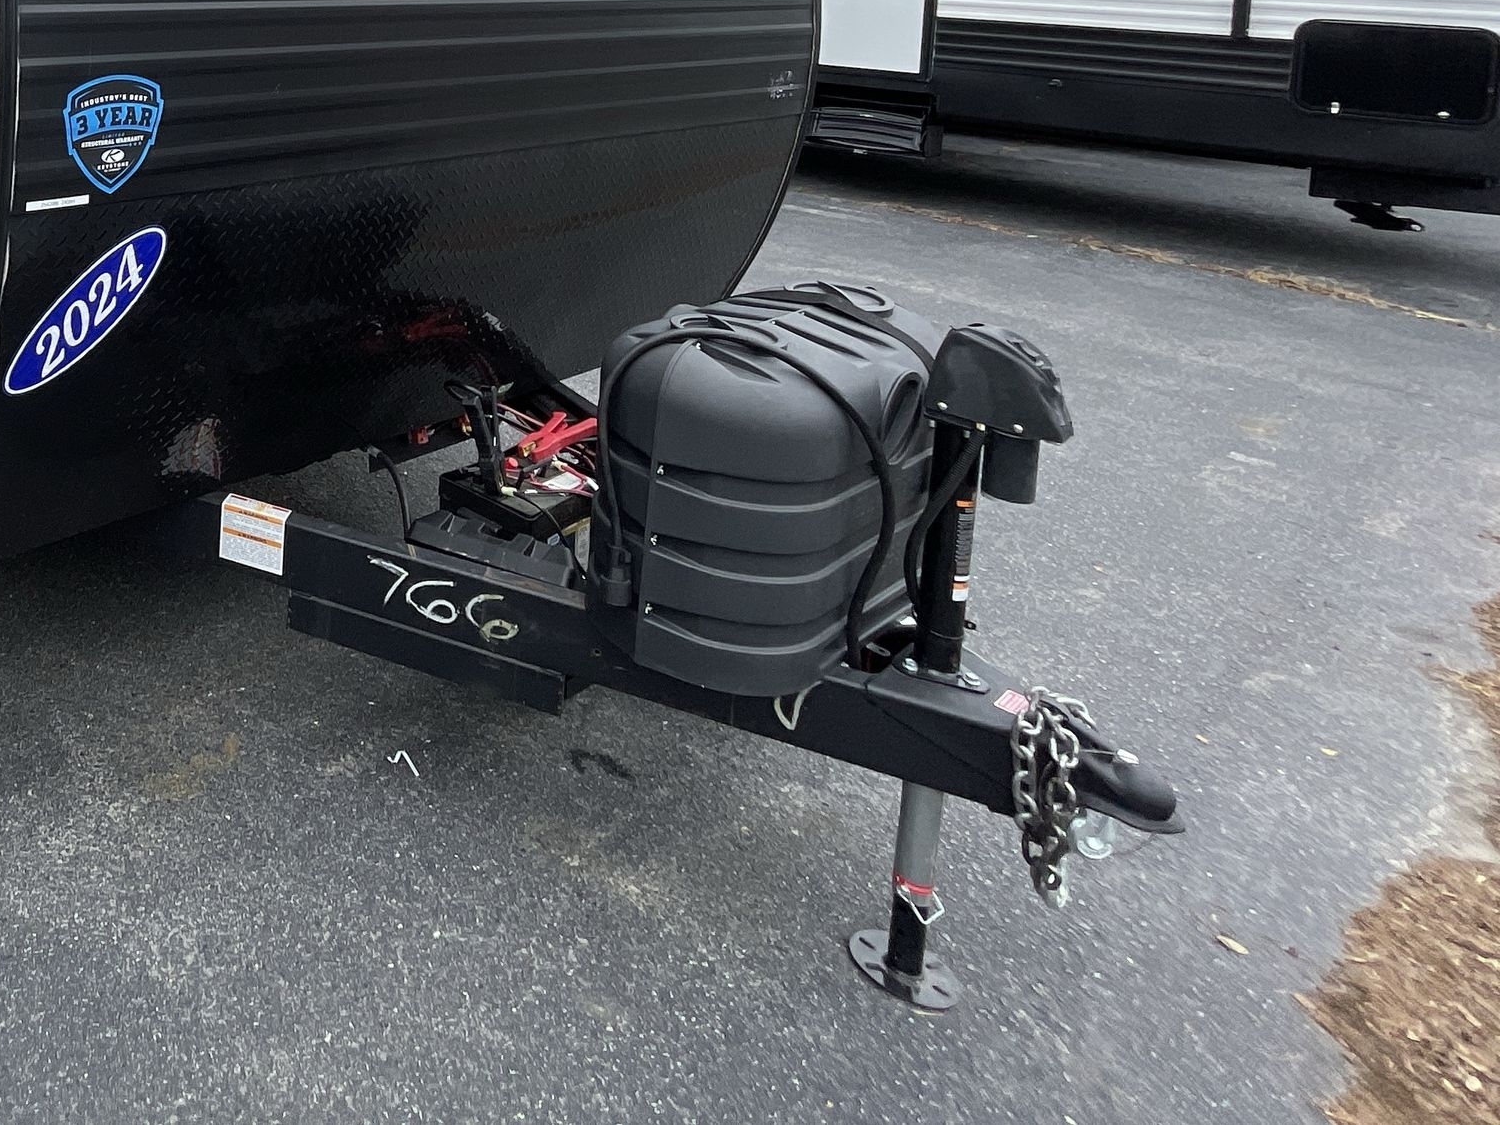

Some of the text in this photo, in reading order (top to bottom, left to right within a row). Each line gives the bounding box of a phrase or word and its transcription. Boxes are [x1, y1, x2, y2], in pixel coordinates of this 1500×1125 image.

[80, 94, 149, 108] INDUSTRY'S BEST
[75, 106, 153, 136] 3 YEAR
[97, 161, 129, 170] KEYSTONE
[35, 243, 145, 379] 2024
[367, 554, 520, 643] 766
